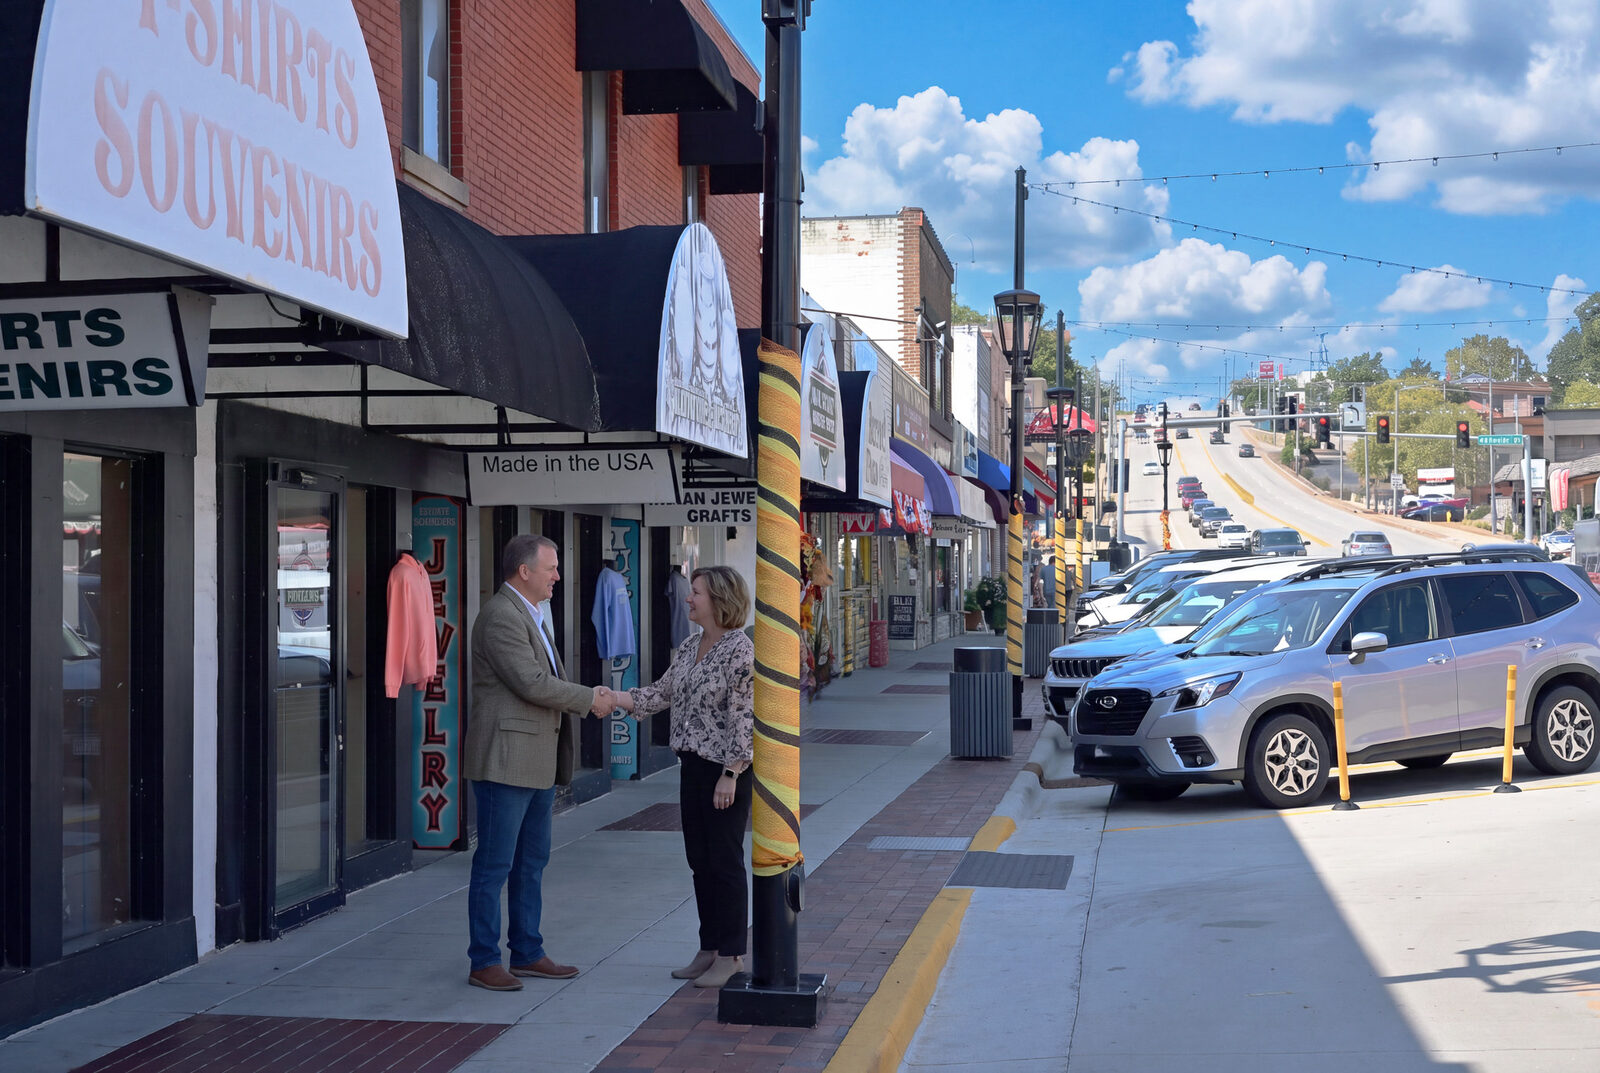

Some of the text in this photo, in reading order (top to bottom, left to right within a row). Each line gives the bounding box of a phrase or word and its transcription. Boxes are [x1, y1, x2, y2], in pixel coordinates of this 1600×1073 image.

[93, 66, 382, 298] SOUVENIRS
[0, 308, 125, 350] RTS
[482, 453, 654, 473] Made in the USA
